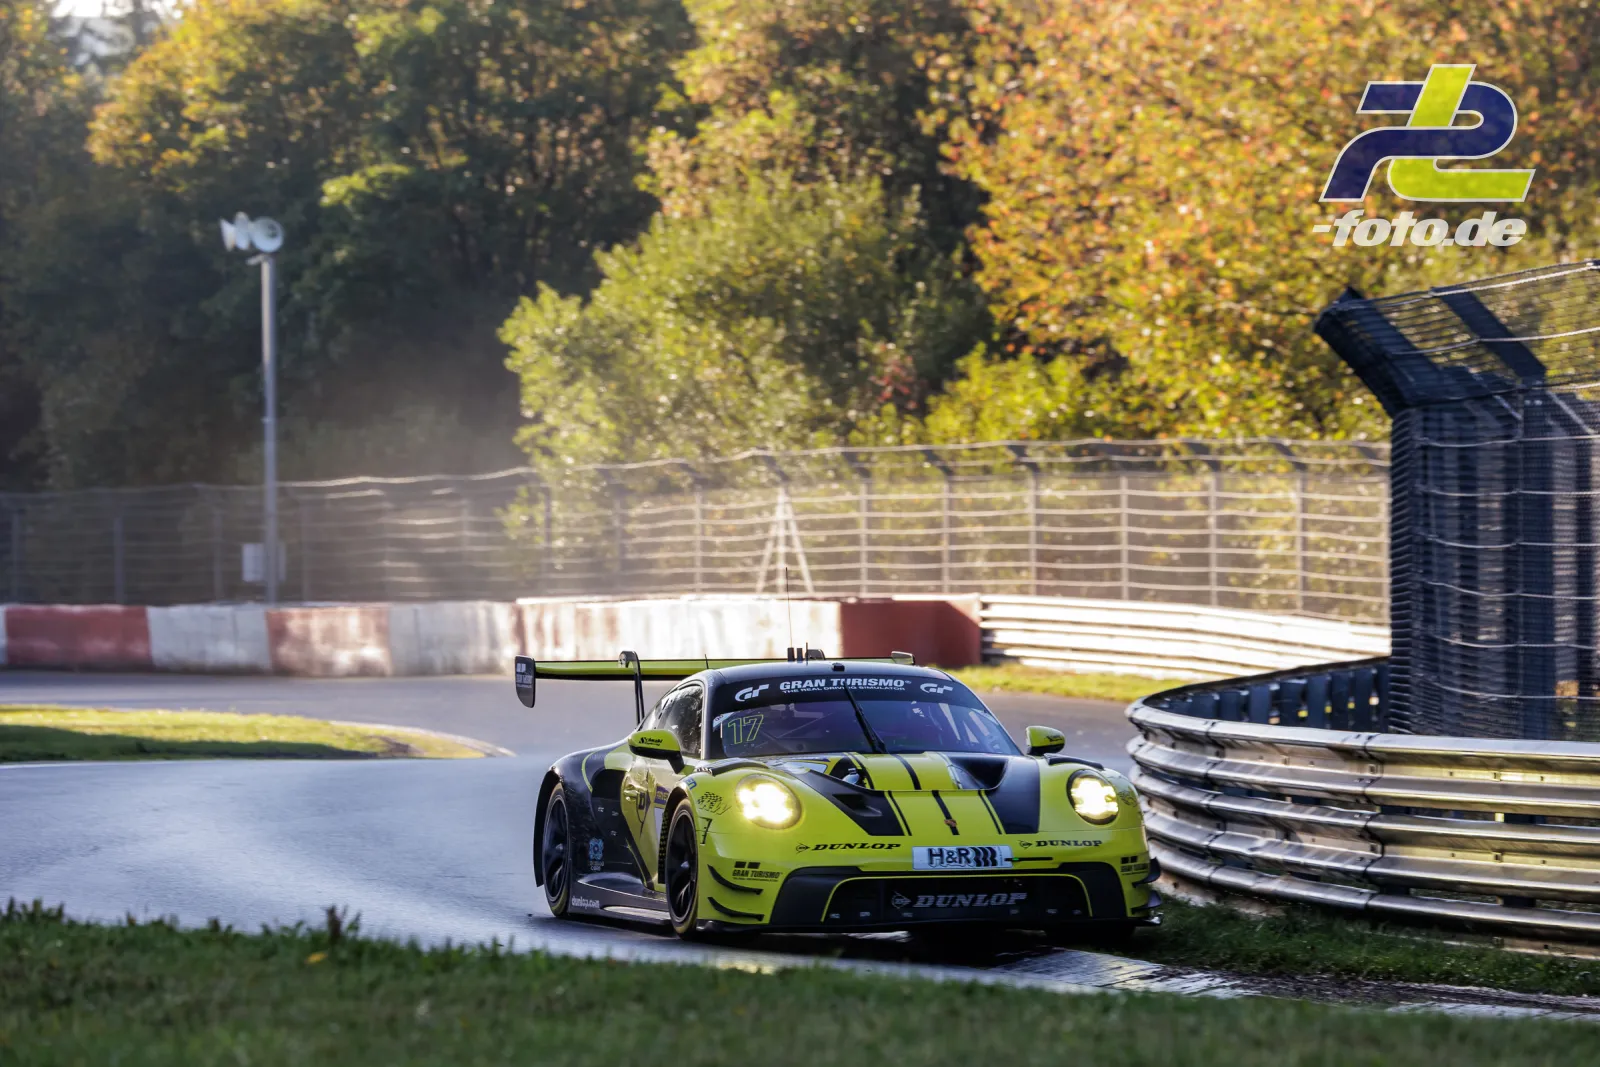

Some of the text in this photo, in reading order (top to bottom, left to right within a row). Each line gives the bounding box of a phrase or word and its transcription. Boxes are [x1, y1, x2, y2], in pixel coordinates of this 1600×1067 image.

[780, 679, 905, 690] GRAN TURISMO
[728, 714, 764, 744] 17
[811, 843, 901, 851] DUNLOP
[928, 847, 971, 867] H&R
[732, 869, 780, 879] GRAN TURISMO
[912, 892, 1027, 908] DUNLOP
